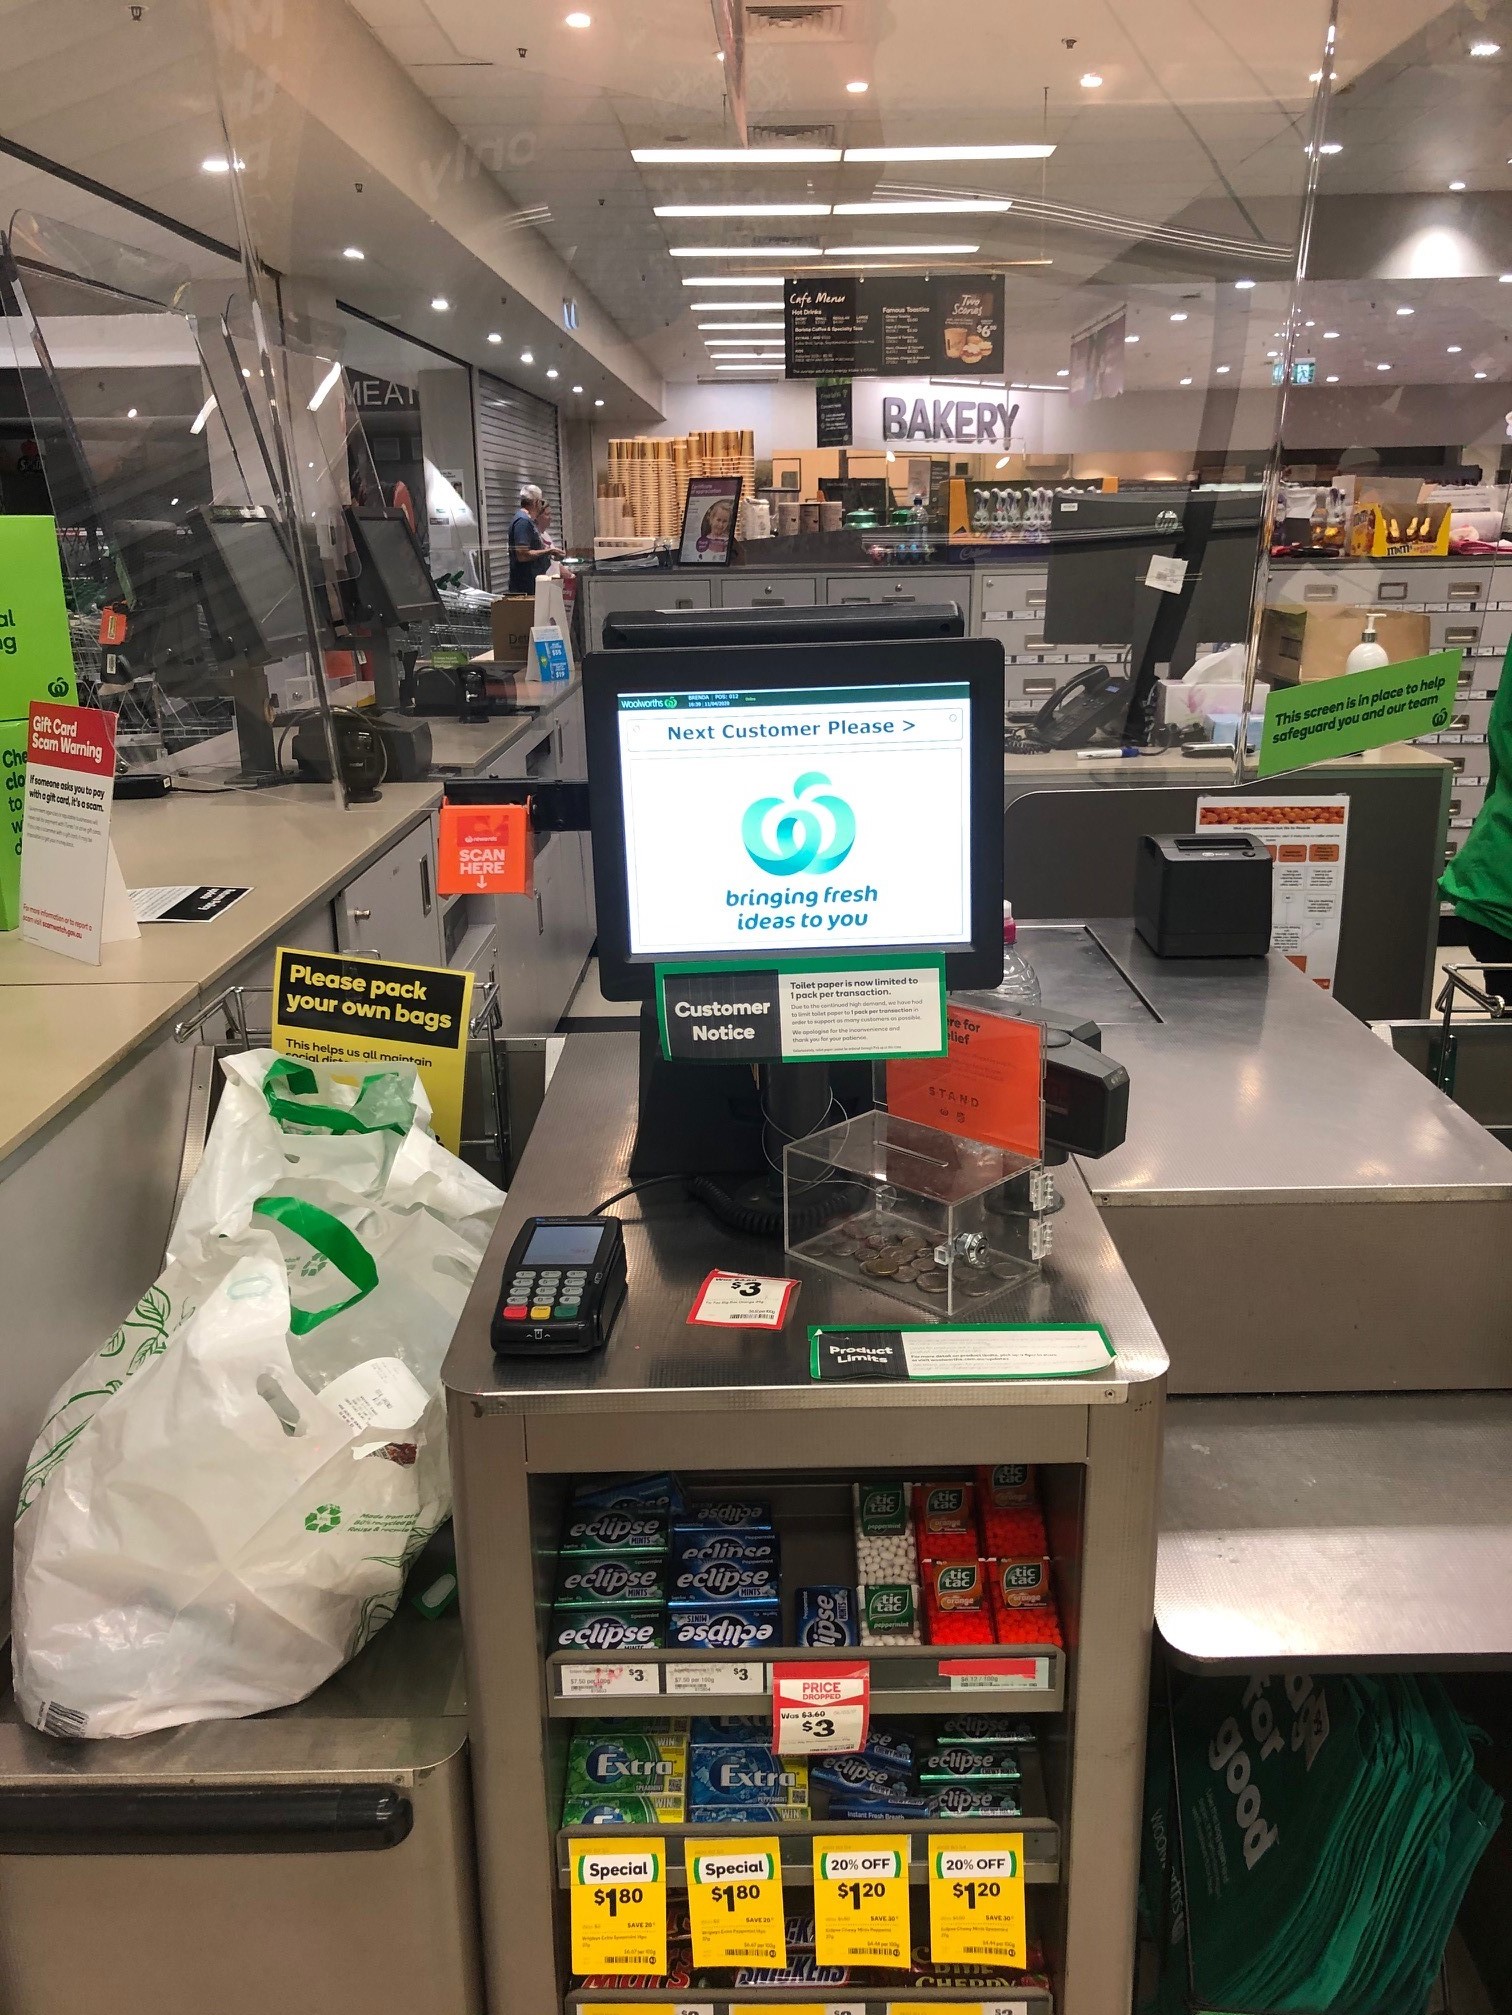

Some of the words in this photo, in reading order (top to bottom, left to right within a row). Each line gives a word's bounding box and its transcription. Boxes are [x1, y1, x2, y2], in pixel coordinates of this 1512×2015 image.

[790, 292, 811, 308] Cafe
[816, 293, 845, 303] Menu
[962, 295, 980, 306] Two
[883, 397, 1019, 450] BAKERY
[1275, 712, 1301, 727] This
[1303, 700, 1344, 720] screen
[1346, 697, 1356, 710] is
[1358, 694, 1369, 706] in
[1371, 686, 1404, 707] place
[1405, 682, 1417, 695] to
[1420, 676, 1445, 692] help
[1272, 721, 1336, 744] safeguard
[1337, 714, 1359, 731] you
[1362, 709, 1384, 721] and
[1386, 702, 1406, 716] our
[1407, 694, 1438, 709] team
[33, 716, 52, 733] Gift
[53, 719, 77, 737] Card
[668, 725, 715, 741] Next
[722, 722, 821, 739] Customer
[828, 719, 895, 736] Please
[32, 733, 59, 752] Scam
[60, 737, 102, 764] Warning
[30, 775, 34, 784] If
[35, 778, 60, 789] someone
[61, 782, 73, 792] asks
[74, 786, 85, 795] you
[86, 786, 92, 795] to
[92, 788, 105, 800] pay
[459, 849, 505, 862] SCAN
[459, 861, 505, 875] HERE
[725, 888, 819, 908] bringing
[823, 886, 878, 903] fresh
[737, 913, 796, 930] ideas
[801, 913, 823, 928] to
[827, 913, 868, 930] you
[290, 965, 366, 992] Please
[370, 980, 427, 1000] pack
[790, 981, 815, 990] Toilet
[818, 981, 843, 990] paper
[875, 978, 907, 986] limited
[796, 990, 818, 1001] pack
[819, 990, 834, 999] per
[836, 988, 892, 997] transaction.
[286, 993, 338, 1013] your
[342, 1000, 391, 1020] own
[395, 1003, 452, 1032] bags
[674, 1001, 771, 1018] Customer
[963, 1019, 980, 1032] for
[692, 1025, 755, 1042] Notice
[285, 1039, 310, 1051] This
[313, 1042, 344, 1056] helps
[347, 1049, 360, 1058] us
[363, 1047, 376, 1060] all
[380, 1053, 432, 1068] maintain
[731, 1282, 762, 1296] $3
[829, 1345, 893, 1355] Product
[837, 1355, 888, 1364] Limits
[999, 1474, 1023, 1484] tac
[879, 1494, 895, 1505] tic
[938, 1490, 953, 1502] tic
[868, 1503, 896, 1514] tac
[931, 1499, 957, 1511] tac
[570, 1518, 660, 1540] eclipse
[631, 1536, 650, 1544] MINTS
[949, 1569, 970, 1580] tic
[1016, 1566, 1036, 1577] tic
[564, 1570, 657, 1592] eclipse
[677, 1565, 769, 1592] eclipse
[944, 1577, 970, 1588] tac
[1011, 1574, 1036, 1585] tac
[627, 1588, 648, 1597] MINTS
[740, 1588, 761, 1596] MINTS
[882, 1593, 903, 1604] tic
[1013, 1593, 1041, 1601] orange
[875, 1602, 902, 1612] tac
[946, 1597, 974, 1605] orange
[838, 1600, 847, 1621] MINTS
[874, 1621, 909, 1629] peppermint
[558, 1624, 654, 1649] eclipse
[677, 1619, 774, 1645] eclipse
[628, 1669, 644, 1682] $3
[733, 1668, 749, 1681] $3
[802, 1682, 841, 1693] PRICE
[802, 1719, 836, 1737] $3
[658, 1738, 675, 1746] WIN
[597, 1753, 673, 1776] Extra
[822, 1756, 888, 1784] eclipse
[928, 1753, 993, 1775] eclipse
[720, 1764, 796, 1787] Extra
[1208, 1716, 1279, 1871] good
[655, 1799, 673, 1808] WIN
[781, 1810, 800, 1819] WIN
[705, 1861, 764, 1879] Special
[831, 1859, 859, 1871] 20%
[861, 1858, 890, 1870] OFF
[946, 1858, 974, 1870] 20%
[976, 1858, 1006, 1870] OFF
[589, 1862, 648, 1880] Special
